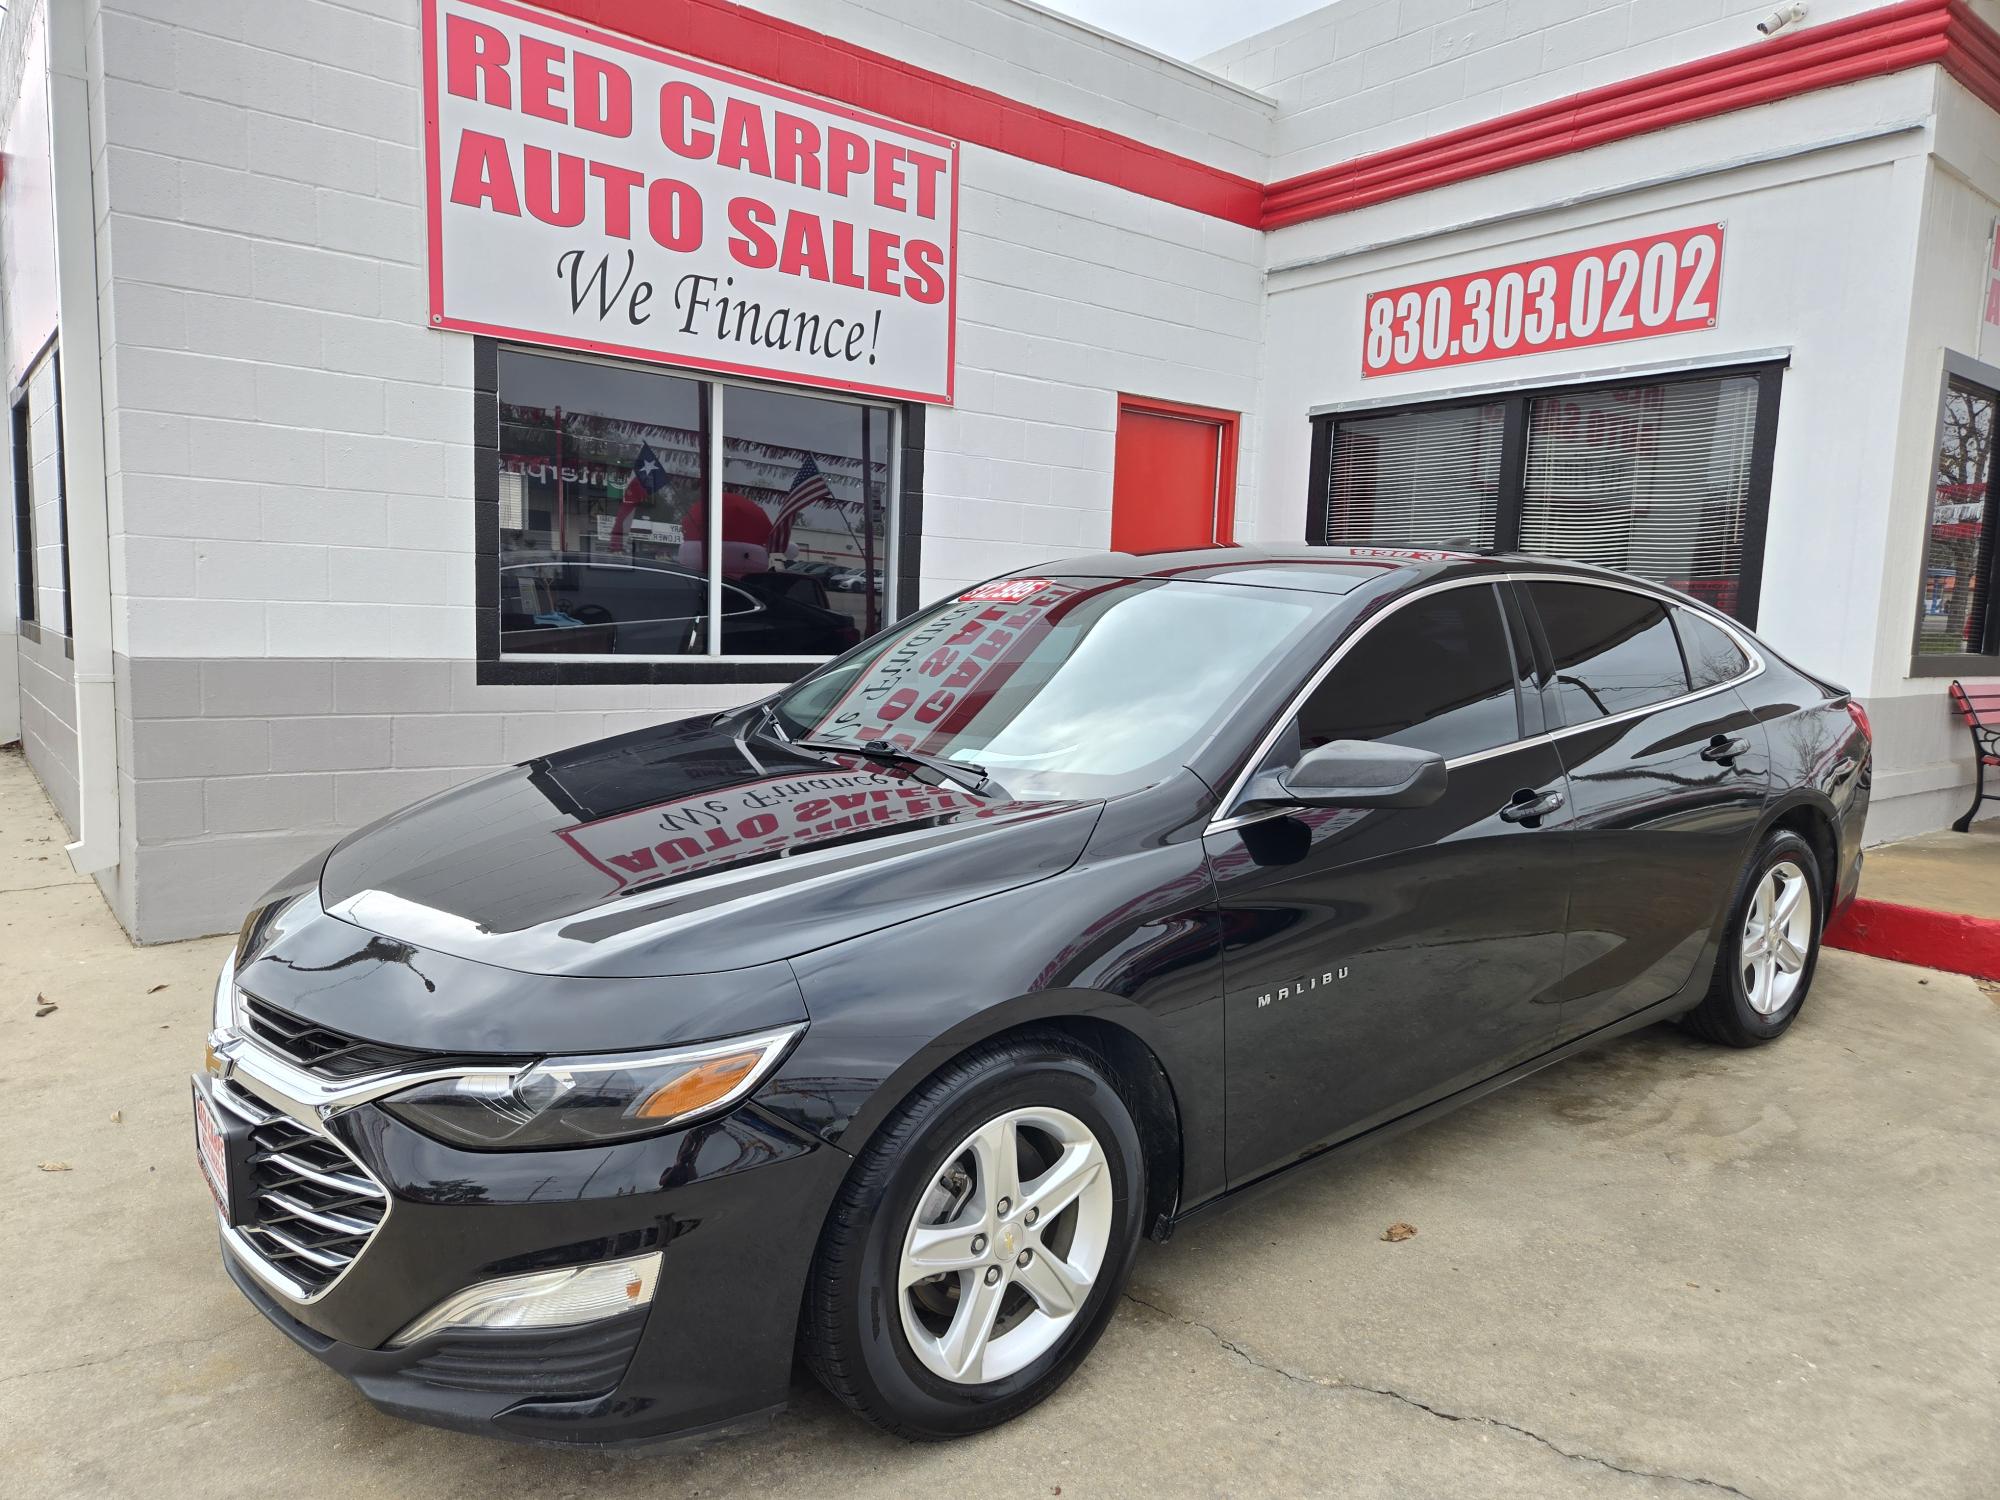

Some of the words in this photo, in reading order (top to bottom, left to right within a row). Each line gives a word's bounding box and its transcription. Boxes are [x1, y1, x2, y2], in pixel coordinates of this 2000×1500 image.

[446, 12, 632, 139] RED
[659, 80, 947, 220] CARPET
[450, 128, 704, 253] AUTO
[727, 196, 945, 305] SALES
[556, 249, 653, 325] We
[674, 273, 882, 365] Finance!
[1366, 234, 1717, 369] 830.303.0202
[1257, 966, 1349, 1009] MALIBU
